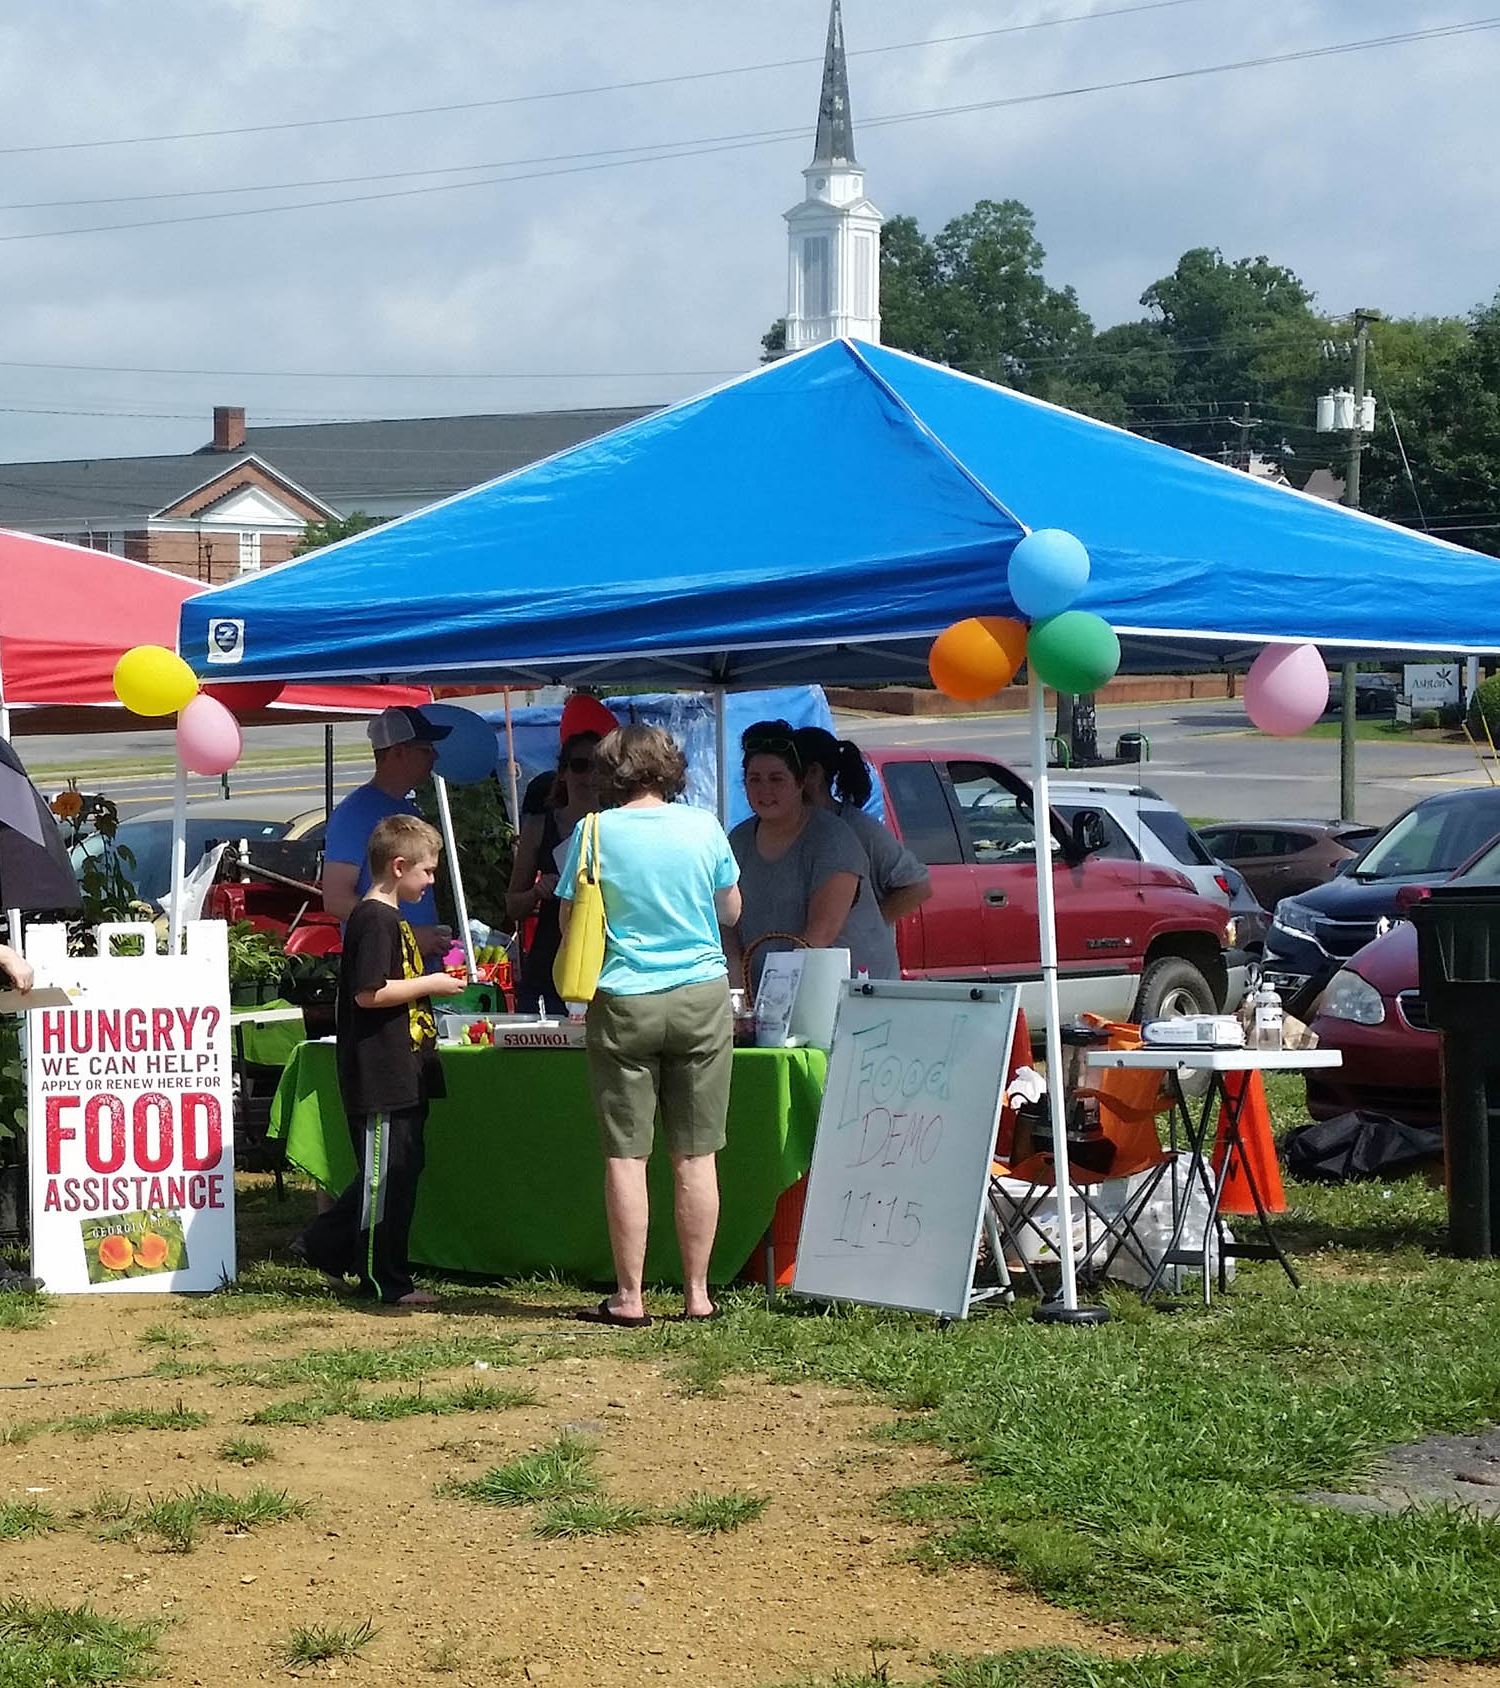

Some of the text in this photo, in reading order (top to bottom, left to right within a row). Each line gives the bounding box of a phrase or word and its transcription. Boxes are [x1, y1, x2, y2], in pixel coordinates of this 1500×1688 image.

[42, 1005, 221, 1054] HUNGRY?
[504, 1033, 570, 1046] TOMATOES
[41, 1053, 219, 1076] WE CAN HELP!
[41, 1076, 221, 1092] APPLY OR RENEW HERE FOR
[837, 1014, 968, 1131] Food
[45, 1091, 223, 1174] FOOD
[845, 1106, 945, 1169] DEMO
[44, 1174, 225, 1212] ASSISTANCE
[92, 1222, 147, 1239] GEORGIA
[832, 1190, 924, 1248] 11:15
